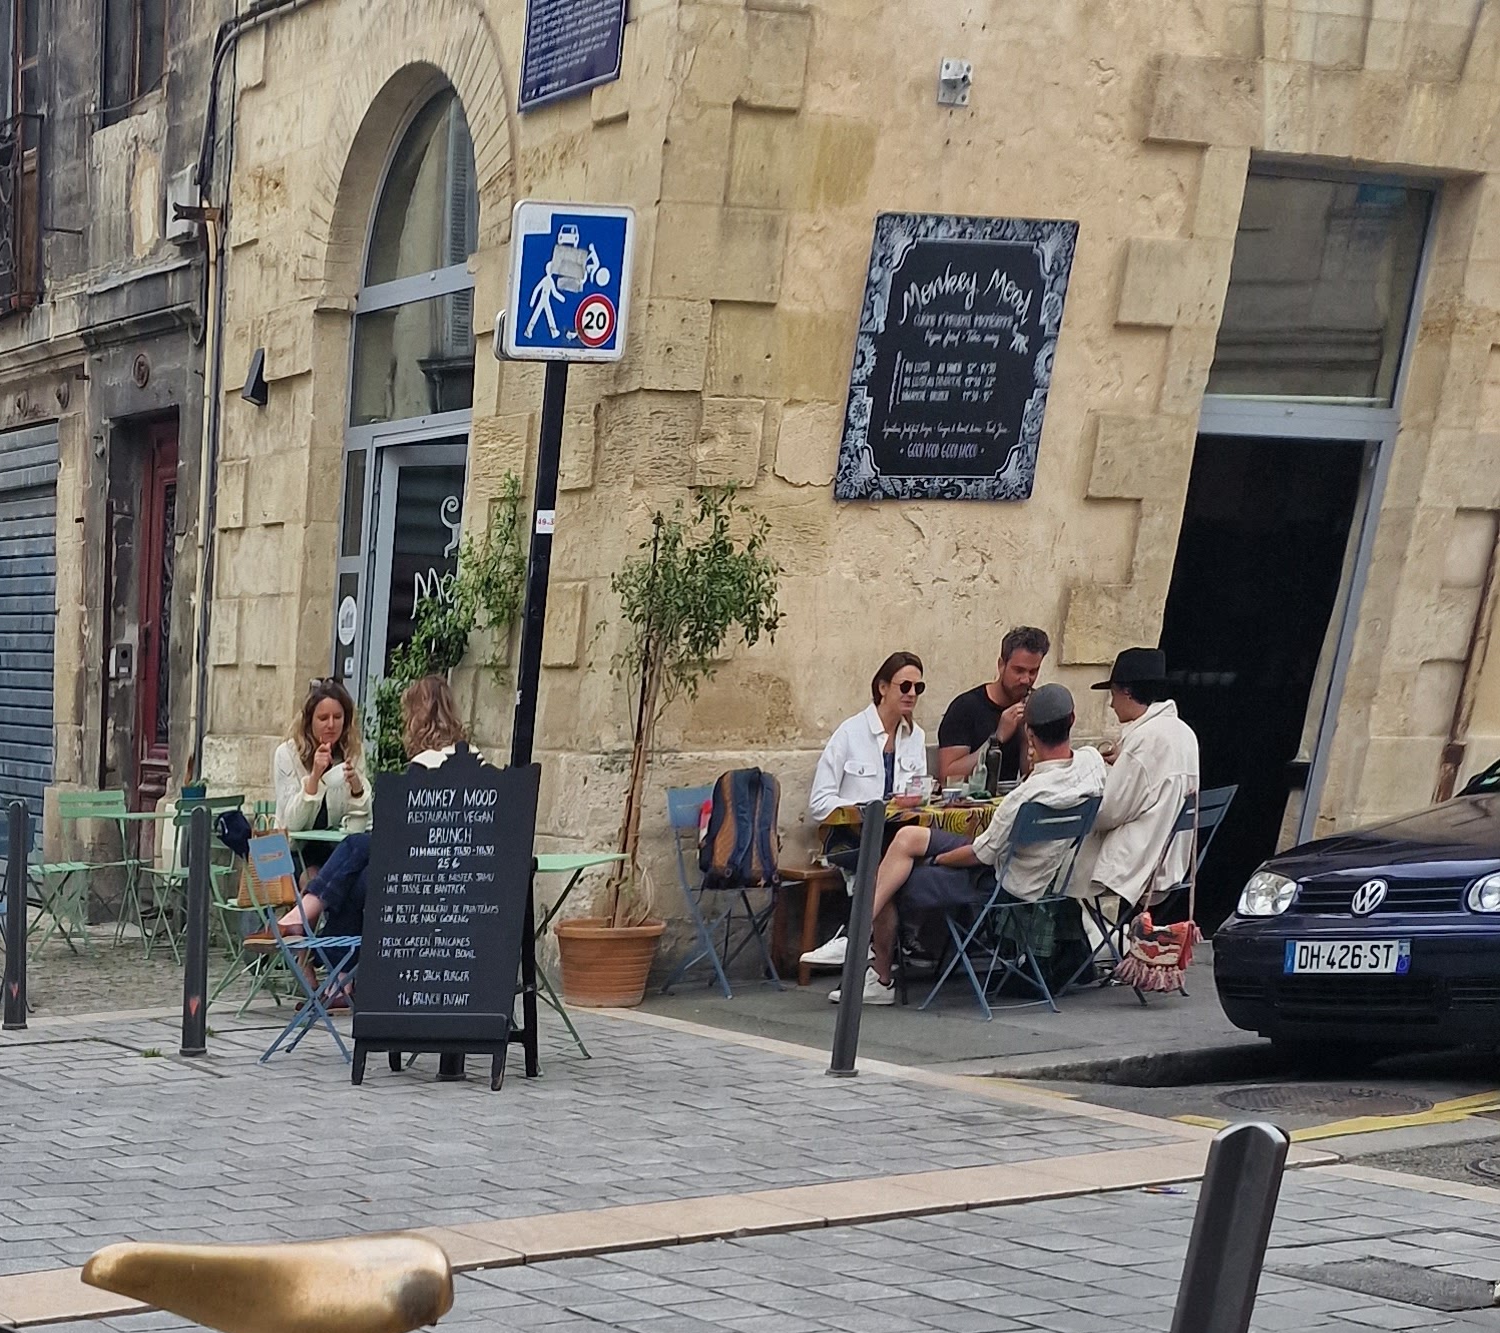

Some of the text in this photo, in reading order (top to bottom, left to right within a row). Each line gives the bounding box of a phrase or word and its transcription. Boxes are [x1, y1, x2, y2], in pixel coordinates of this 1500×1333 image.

[899, 261, 1034, 326] Monkey Mood
[584, 311, 607, 330] 20
[407, 787, 499, 808] MONKEY MOOD
[407, 810, 495, 824] RESTAURANT VEGAN
[428, 827, 473, 844] BRUNCH
[409, 846, 452, 857] DIMANCHE
[1298, 943, 1394, 970] DH-426-ST
